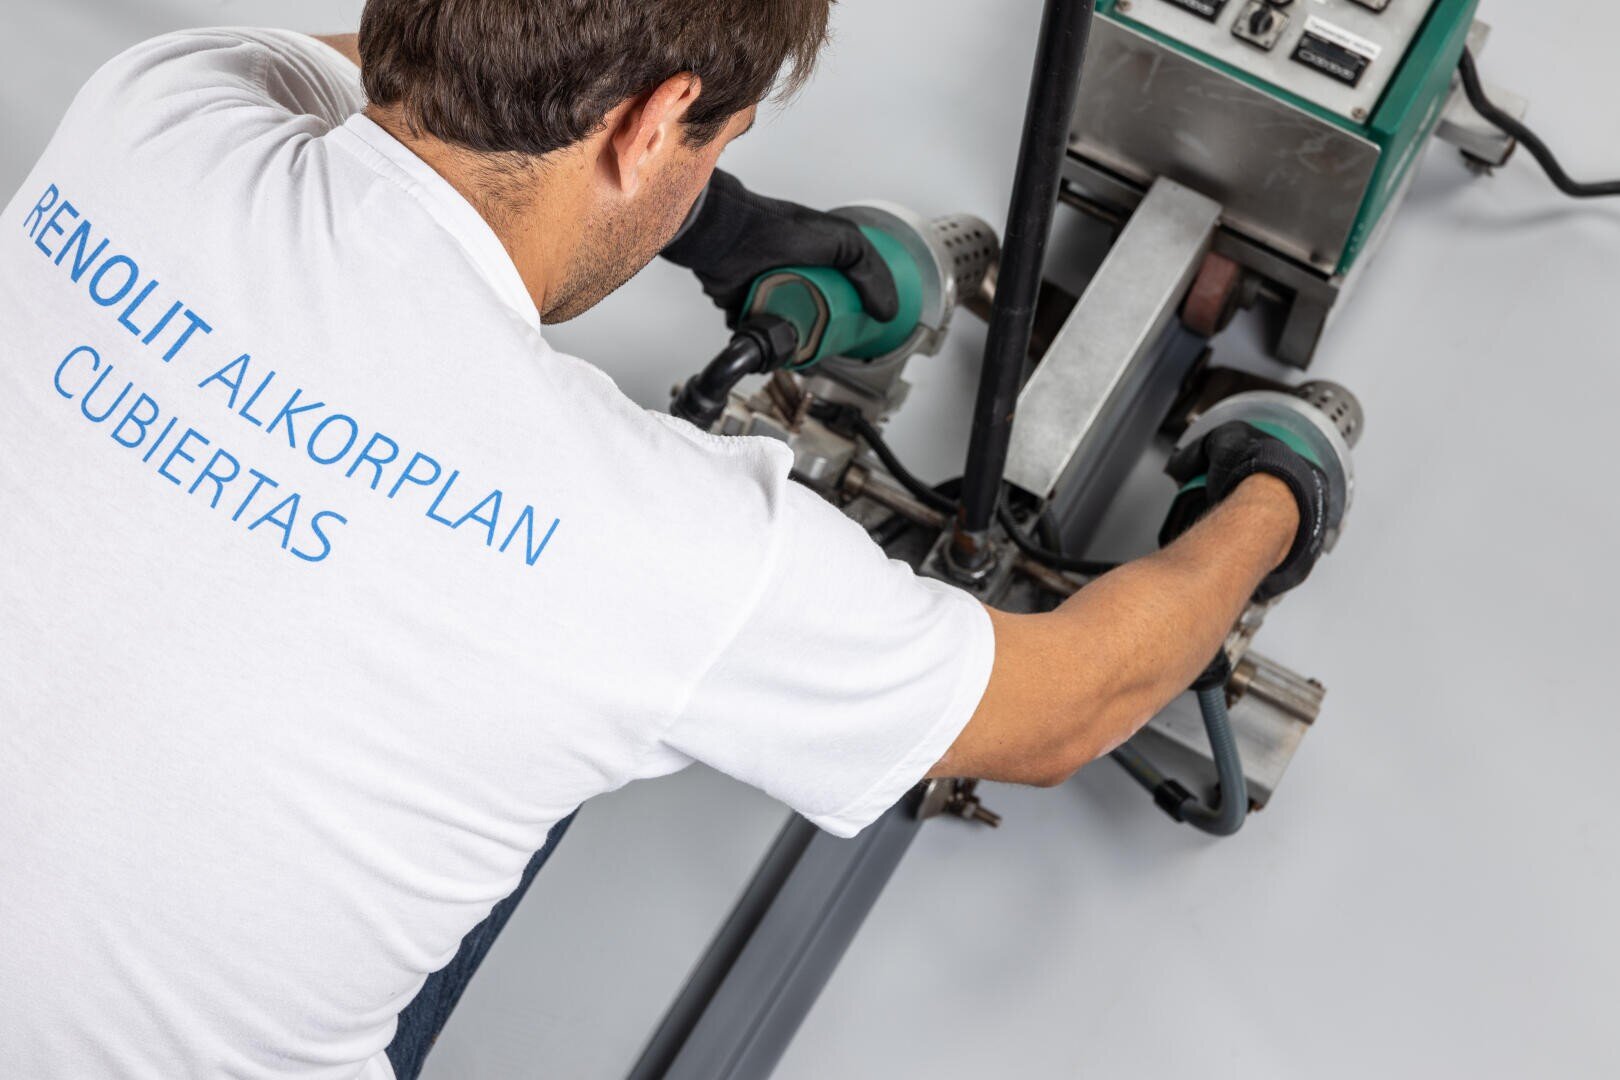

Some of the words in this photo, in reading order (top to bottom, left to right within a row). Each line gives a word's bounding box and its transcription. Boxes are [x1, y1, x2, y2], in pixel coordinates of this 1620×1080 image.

[24, 183, 213, 363] RENOLIT
[198, 353, 560, 566] ALKORPLAN
[53, 345, 348, 563] CUBIERTAS
